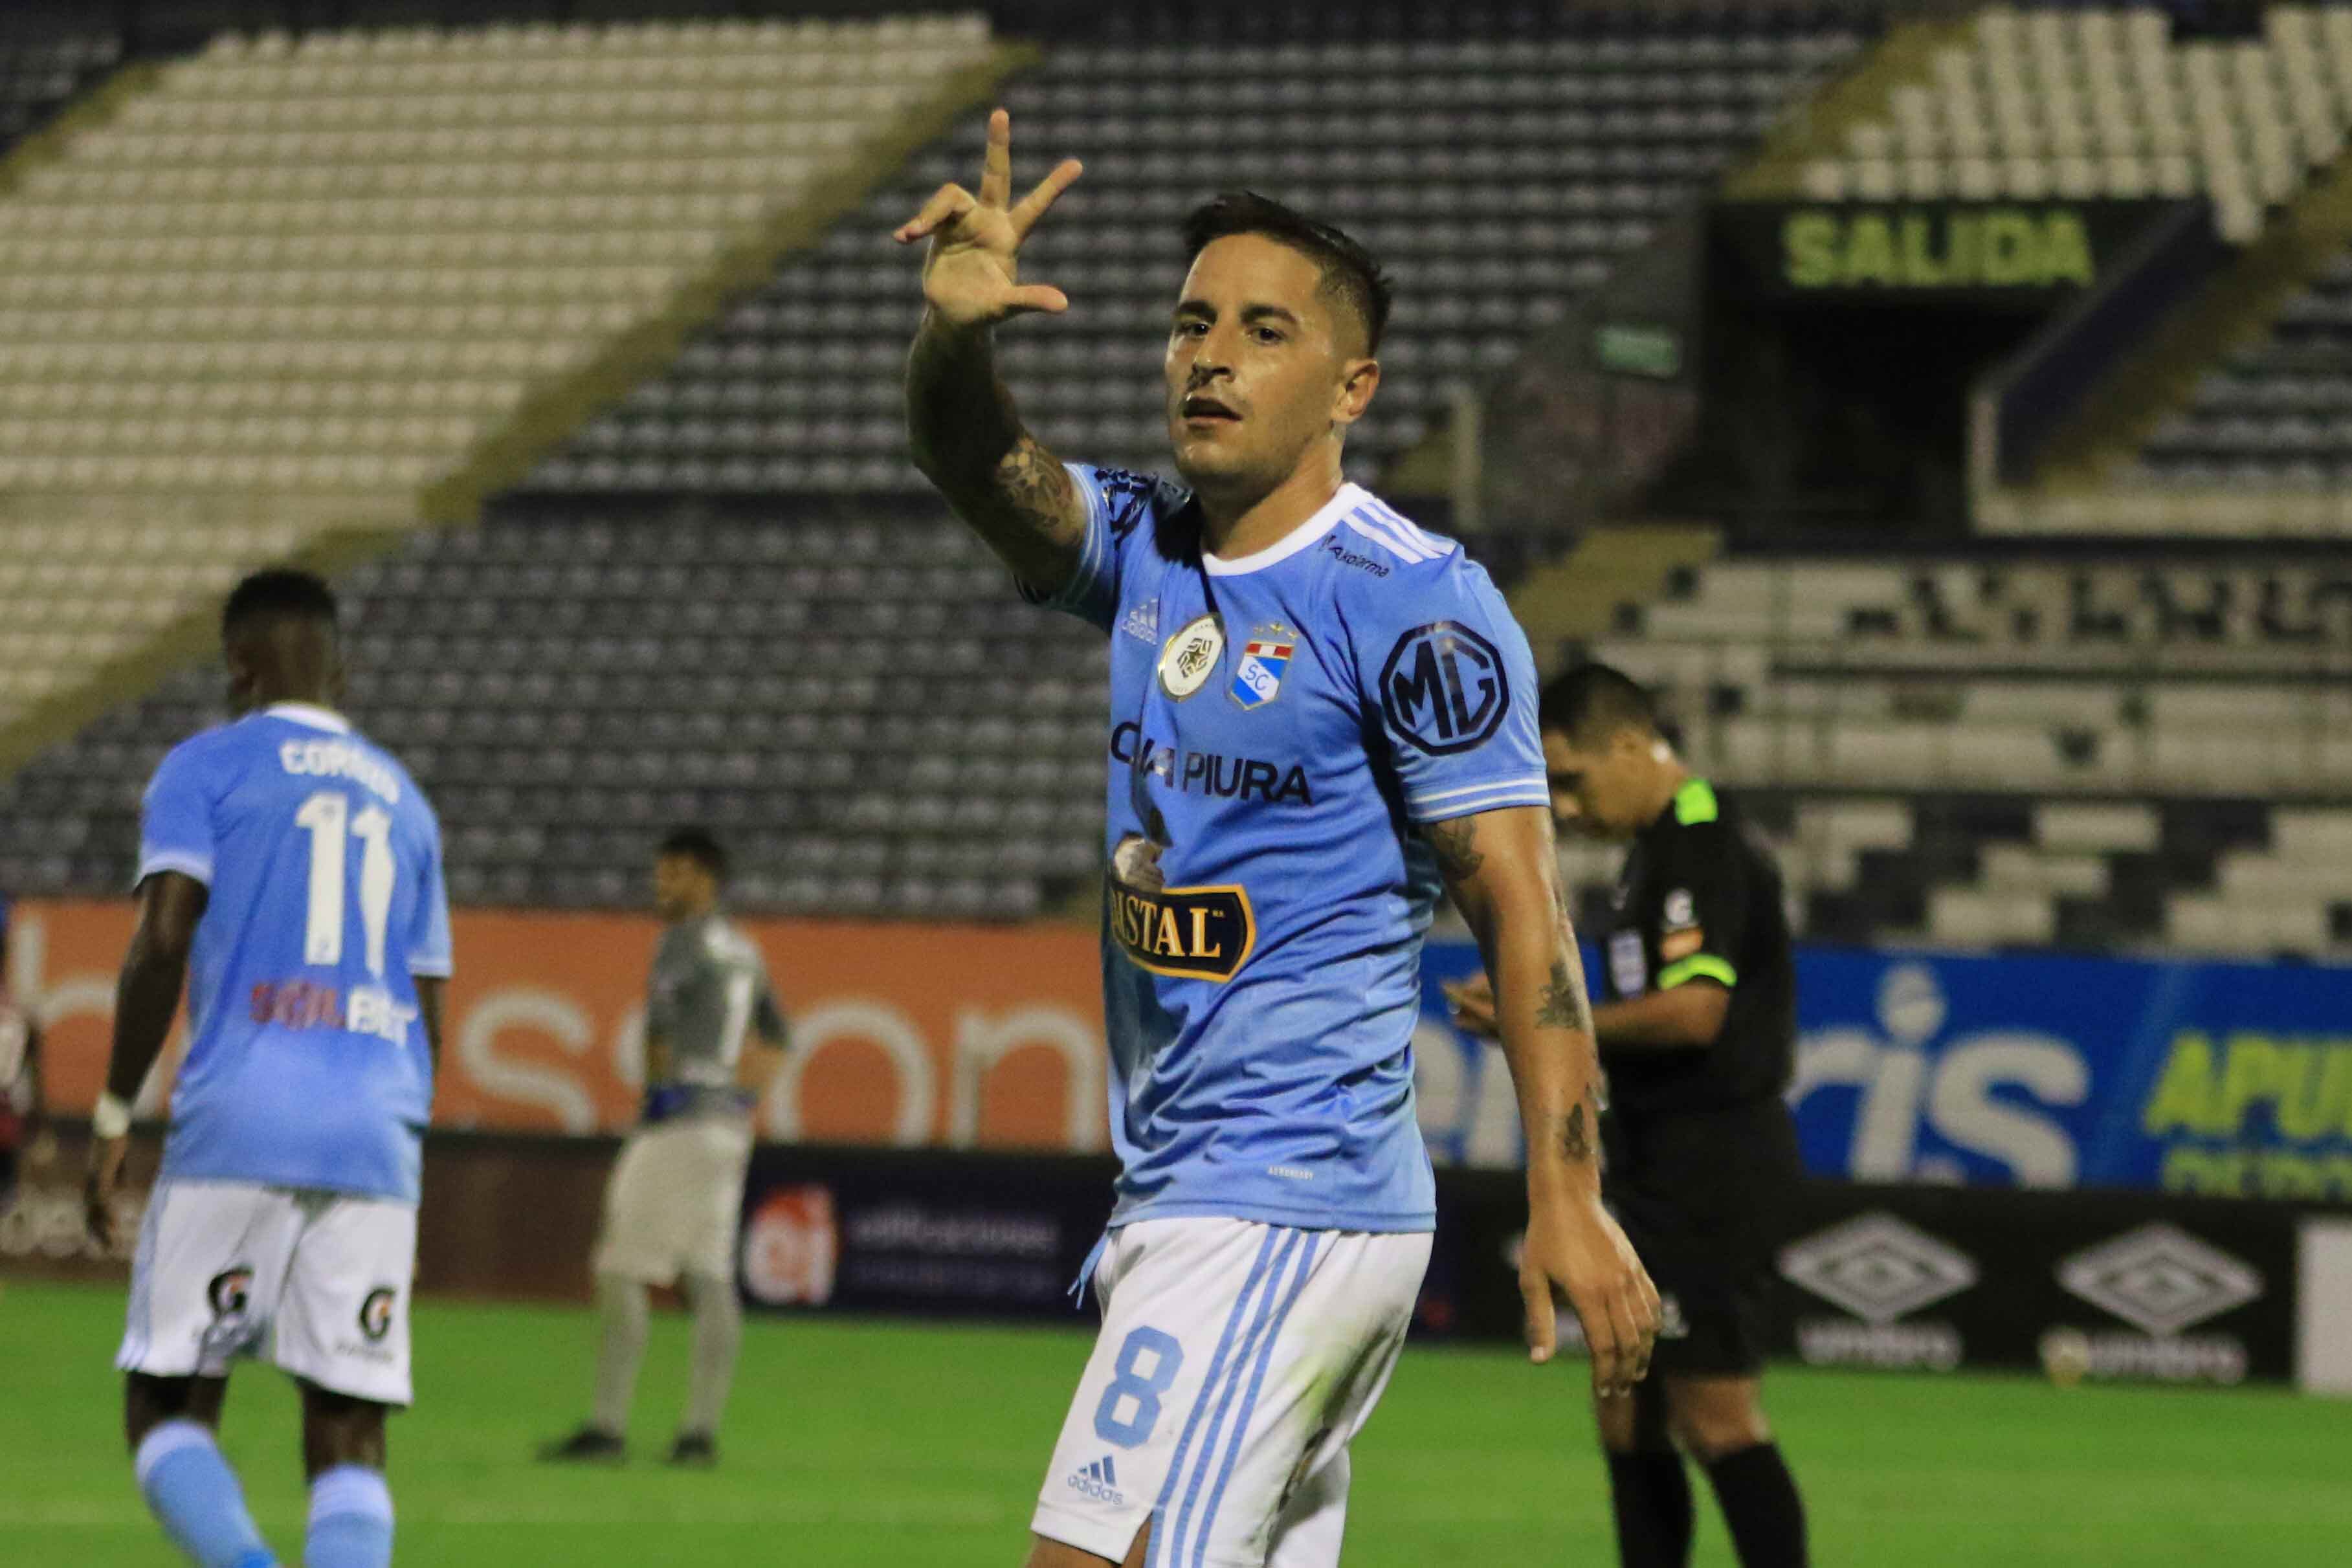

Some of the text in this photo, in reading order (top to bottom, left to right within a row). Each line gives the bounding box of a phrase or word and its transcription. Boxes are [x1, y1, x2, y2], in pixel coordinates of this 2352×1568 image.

[1782, 209, 2094, 287] SALIDA
[1245, 663, 1270, 691] SC
[1390, 637, 1496, 742] MG
[1181, 751, 1314, 806] PIURA
[294, 792, 397, 979] 11
[1094, 1325, 1184, 1450] 8
[1067, 1474, 1125, 1507] adidas
